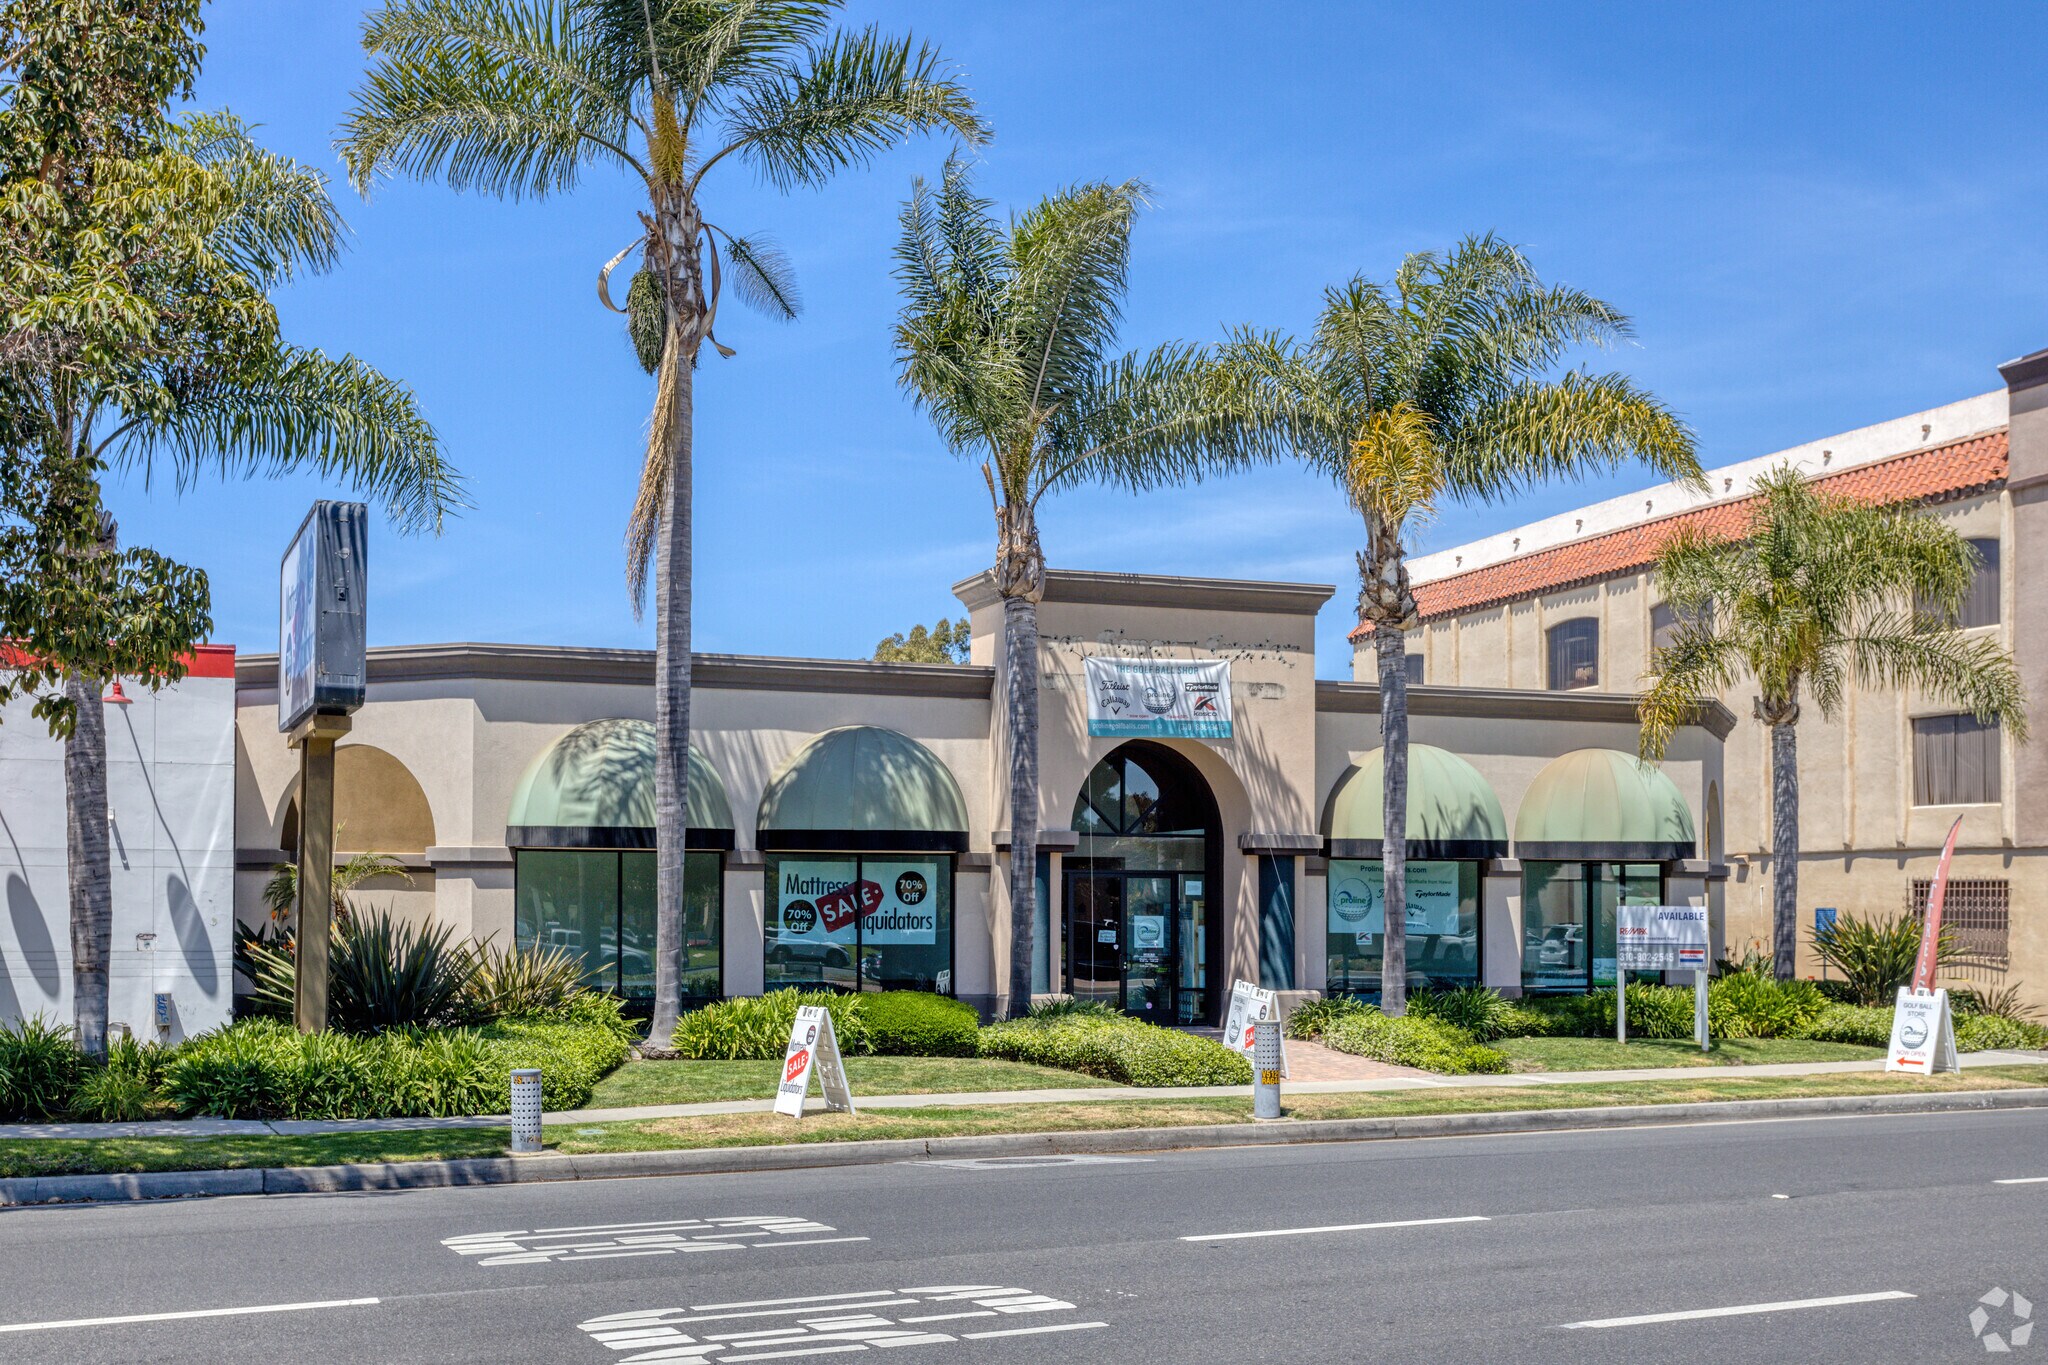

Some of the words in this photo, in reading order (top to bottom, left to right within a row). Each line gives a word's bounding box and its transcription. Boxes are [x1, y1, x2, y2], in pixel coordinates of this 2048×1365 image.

[1115, 665, 1130, 673] THE
[1133, 665, 1153, 674] GOLF
[1155, 666, 1175, 675] BALL
[1177, 666, 1199, 675] SHOP
[1100, 680, 1130, 691] Titleist
[1101, 696, 1130, 708] Callaway
[786, 874, 849, 896] Mattress
[900, 880, 923, 889] 70%
[903, 892, 919, 902] Off
[1415, 890, 1451, 898] TaylorMade
[1341, 896, 1367, 905] proline
[788, 909, 812, 919] 70%
[1658, 912, 1704, 920] AVAILABLE
[791, 922, 808, 932] Off
[1620, 953, 1674, 962] 310-802-2545
[788, 1055, 805, 1075] SALE
